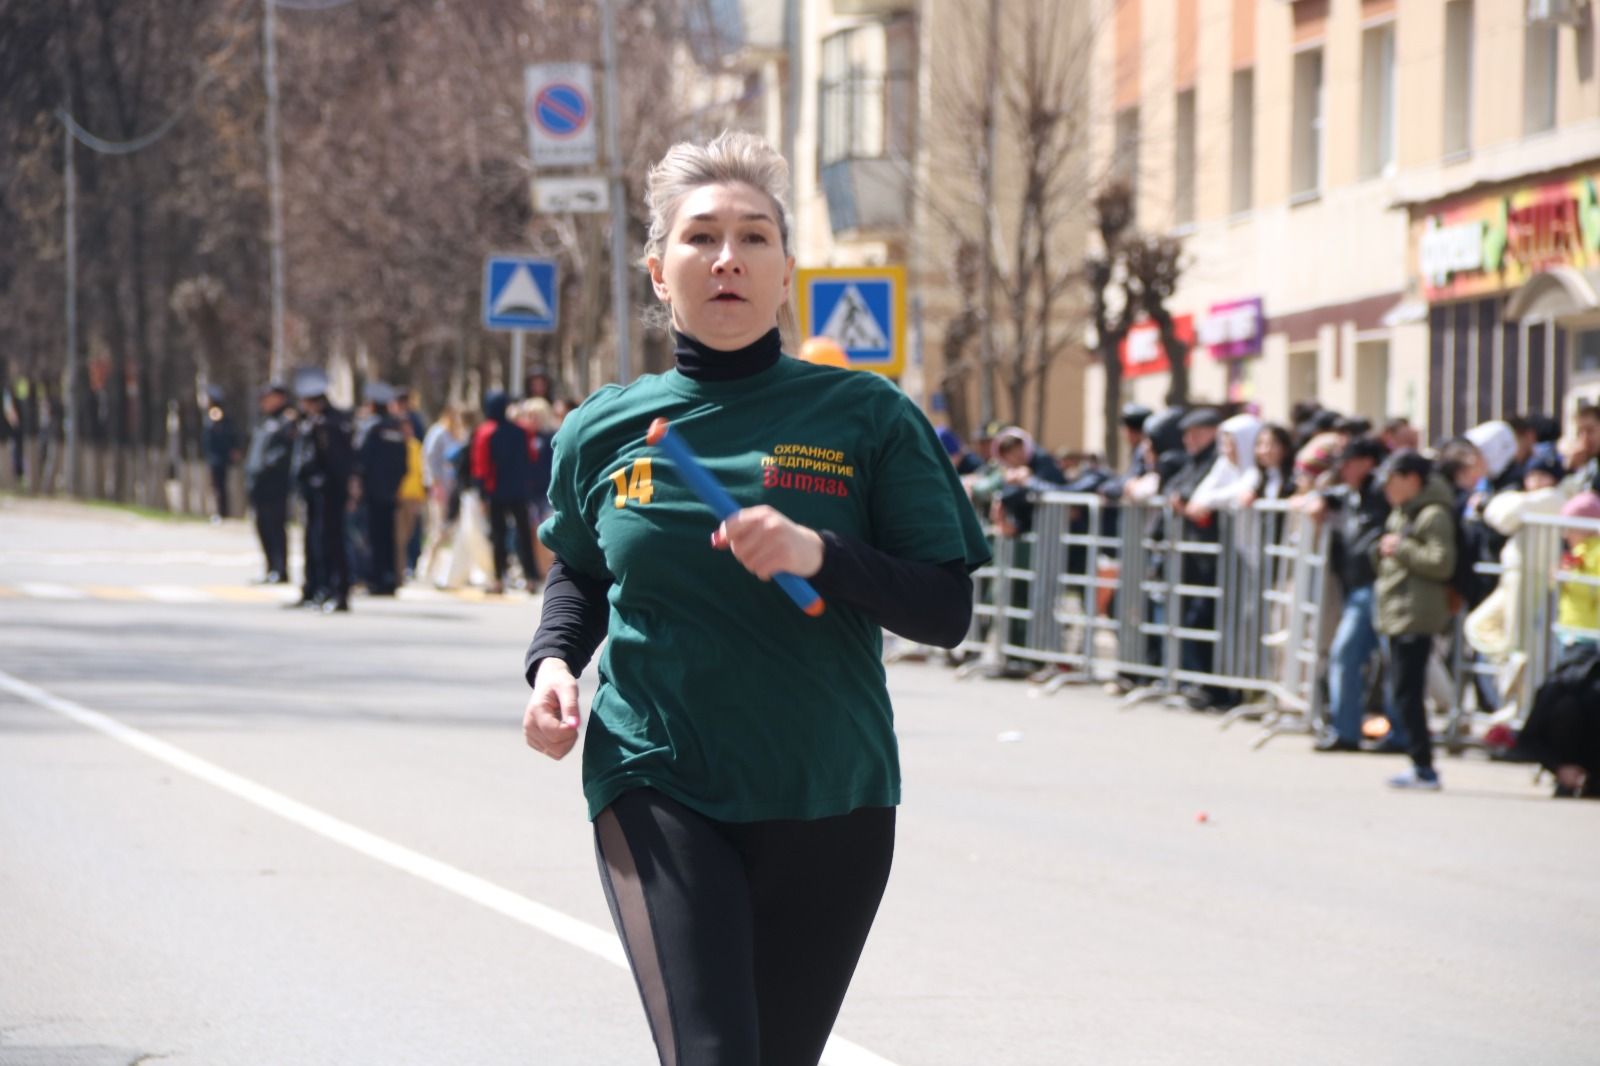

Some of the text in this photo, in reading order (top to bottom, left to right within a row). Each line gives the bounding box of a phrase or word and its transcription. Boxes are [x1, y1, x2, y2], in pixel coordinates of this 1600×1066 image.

[774, 444, 845, 463] ОХРАННОЕ
[761, 455, 854, 478] ПРЕДПРИЯТИЕ
[609, 457, 654, 509] 14
